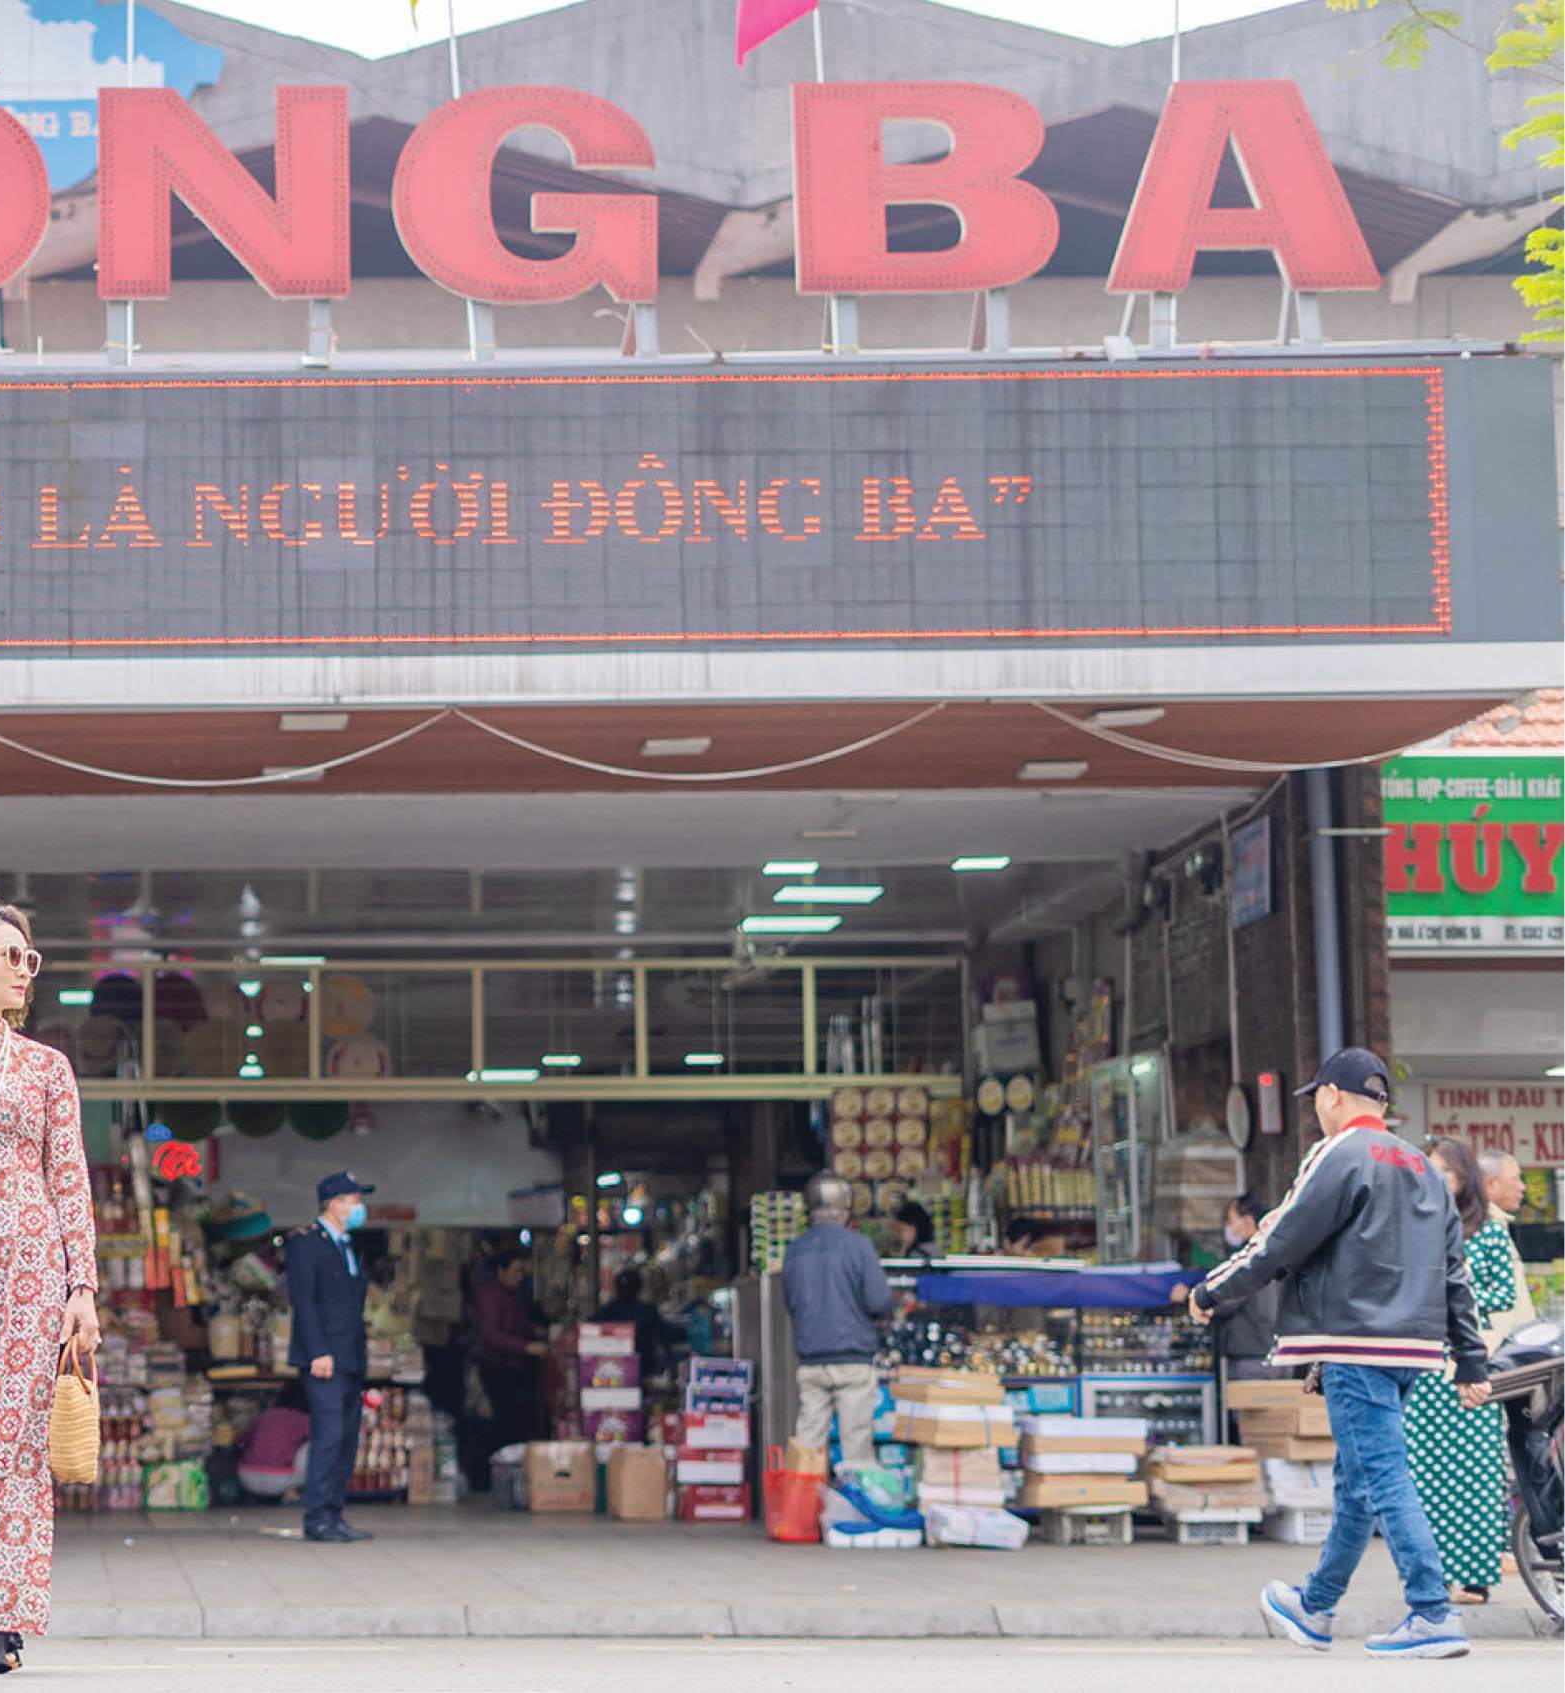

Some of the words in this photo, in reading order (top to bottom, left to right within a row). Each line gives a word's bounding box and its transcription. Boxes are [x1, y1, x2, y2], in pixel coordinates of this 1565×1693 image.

[791, 79, 1382, 296] BA
[30, 465, 164, 549] LÀ
[540, 453, 821, 543] ĐÔNG
